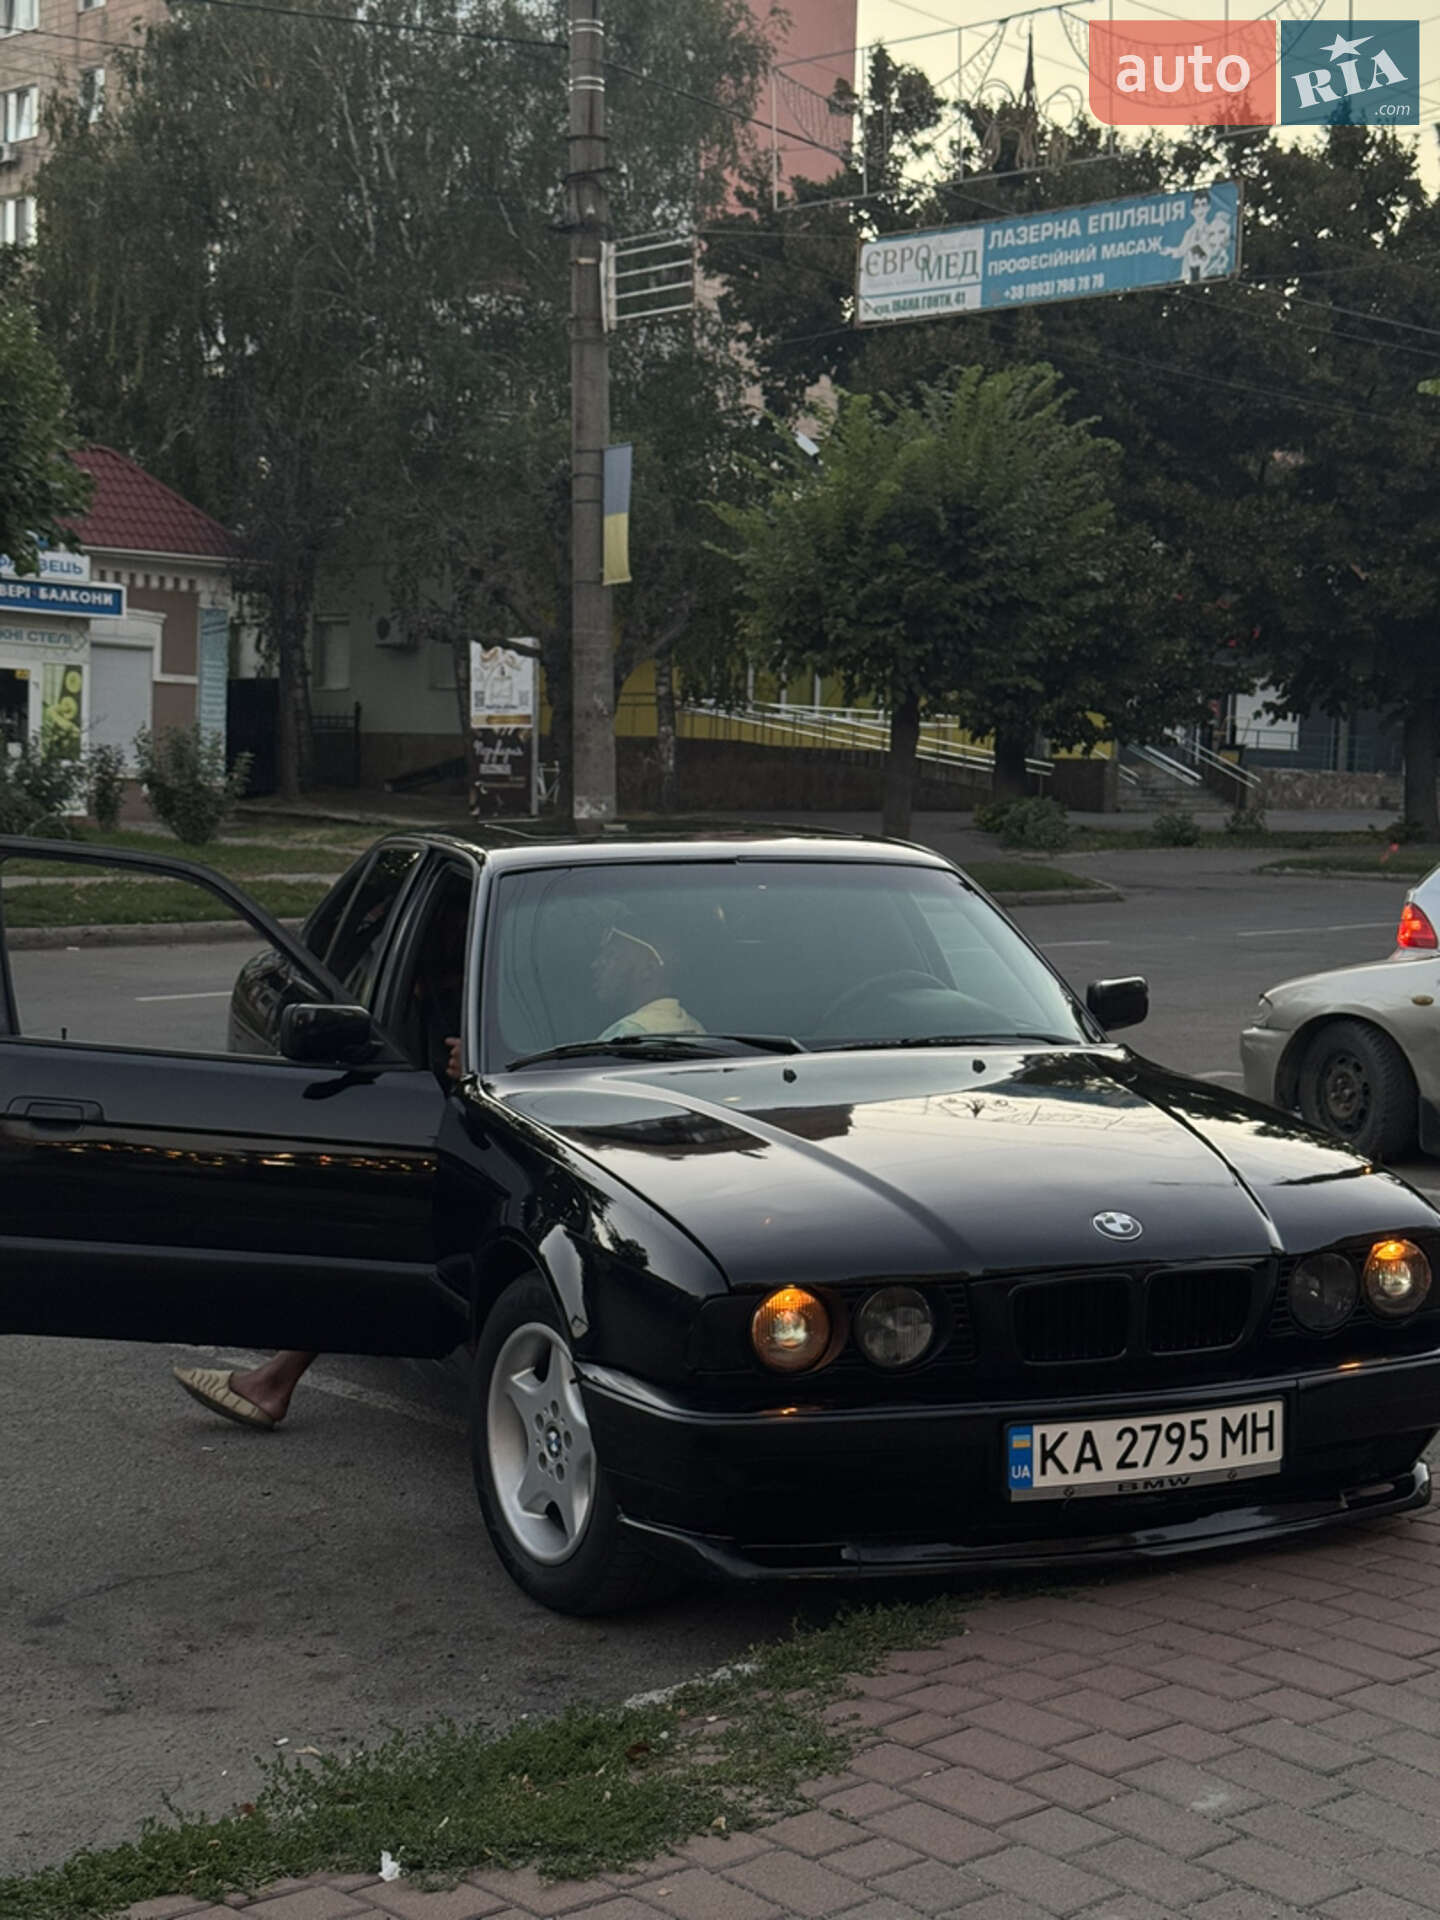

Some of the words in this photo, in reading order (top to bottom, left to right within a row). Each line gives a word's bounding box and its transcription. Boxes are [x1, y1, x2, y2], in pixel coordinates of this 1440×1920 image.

[988, 218, 1081, 250] ЛАЗЕРНА
[1087, 200, 1186, 235] ЕПІЛЯЦІЯ
[988, 247, 1096, 277] ПРОФЕСІЙНИЙ
[1101, 235, 1163, 261] МАСАЖ
[38, 587, 114, 606] БАЛКОНИ
[1039, 1429, 1103, 1476] KA
[1115, 1418, 1209, 1470] 2795
[1220, 1409, 1275, 1458] MH
[1011, 1464, 1031, 1479] UA
[1117, 1476, 1191, 1492] BMW
